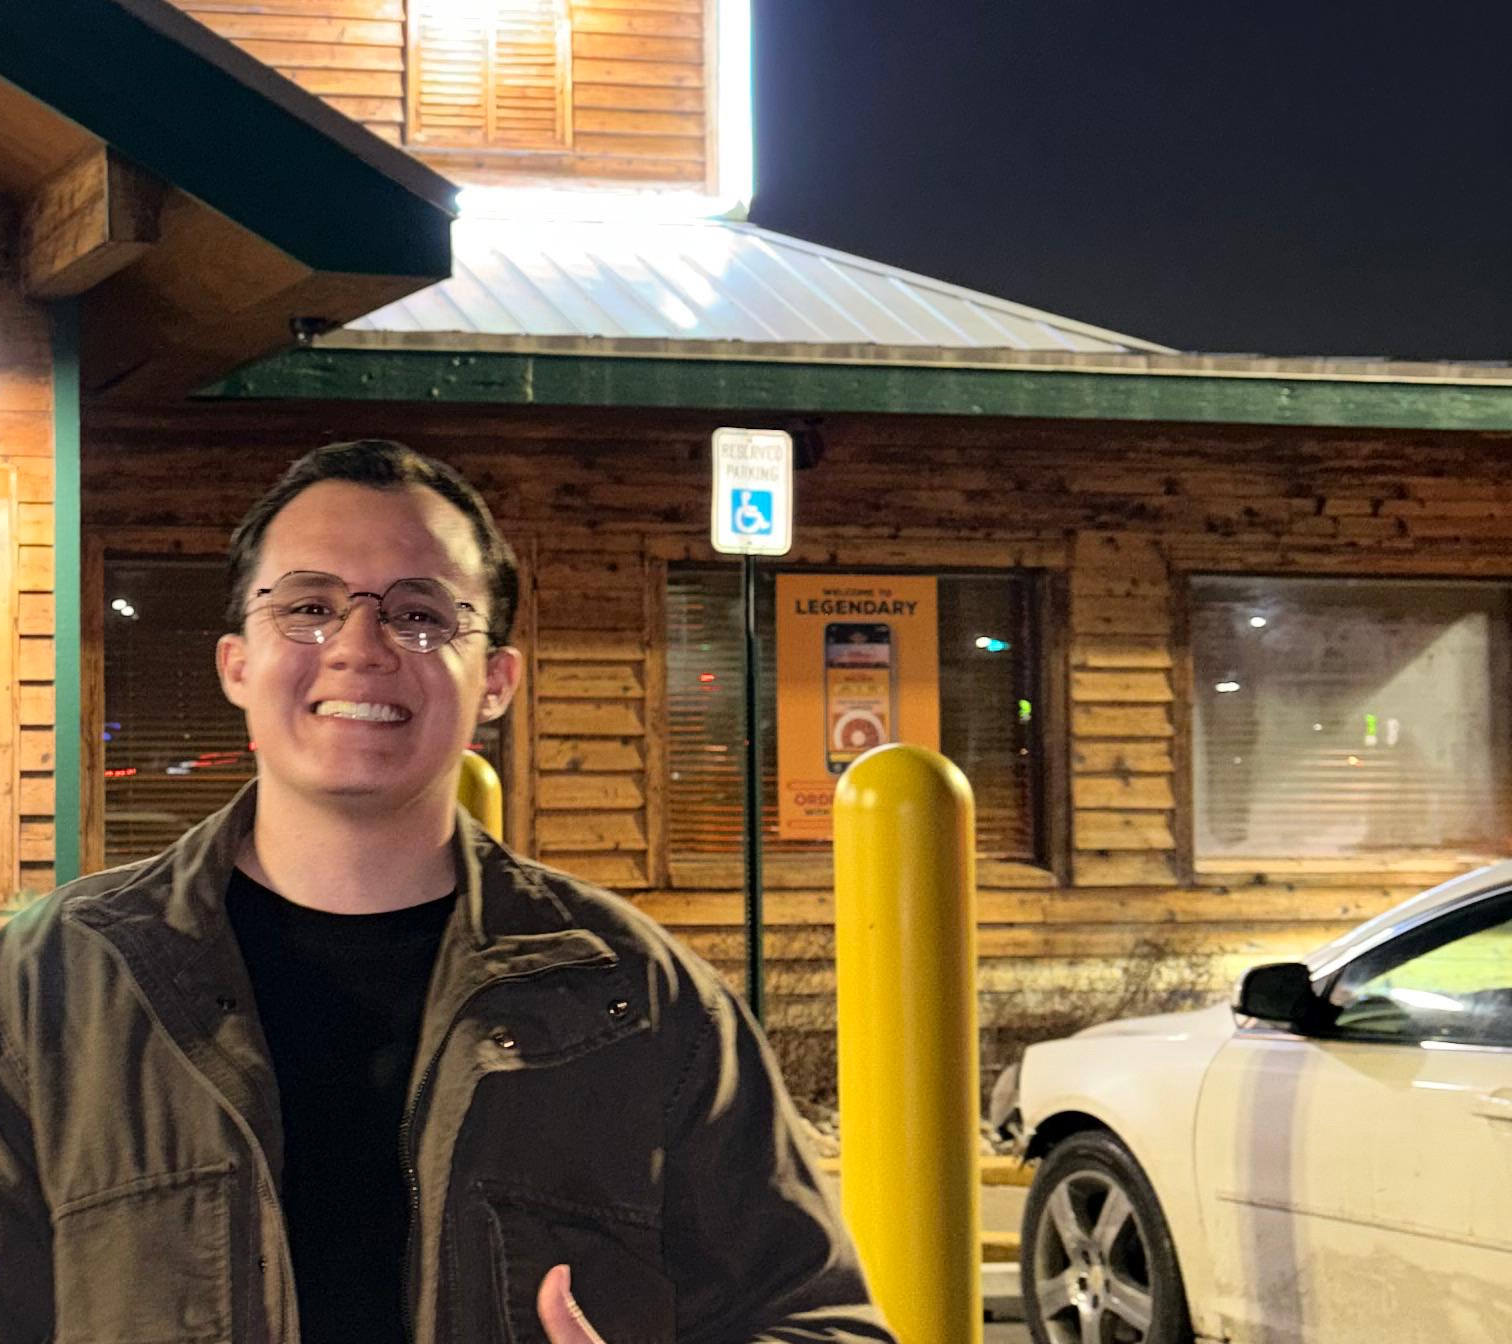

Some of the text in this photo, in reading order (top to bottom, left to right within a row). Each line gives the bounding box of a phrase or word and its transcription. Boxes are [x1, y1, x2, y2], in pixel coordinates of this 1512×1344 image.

[721, 443, 783, 461] RESERVED
[726, 463, 779, 481] PARKING
[794, 599, 918, 616] LEGENDARY
